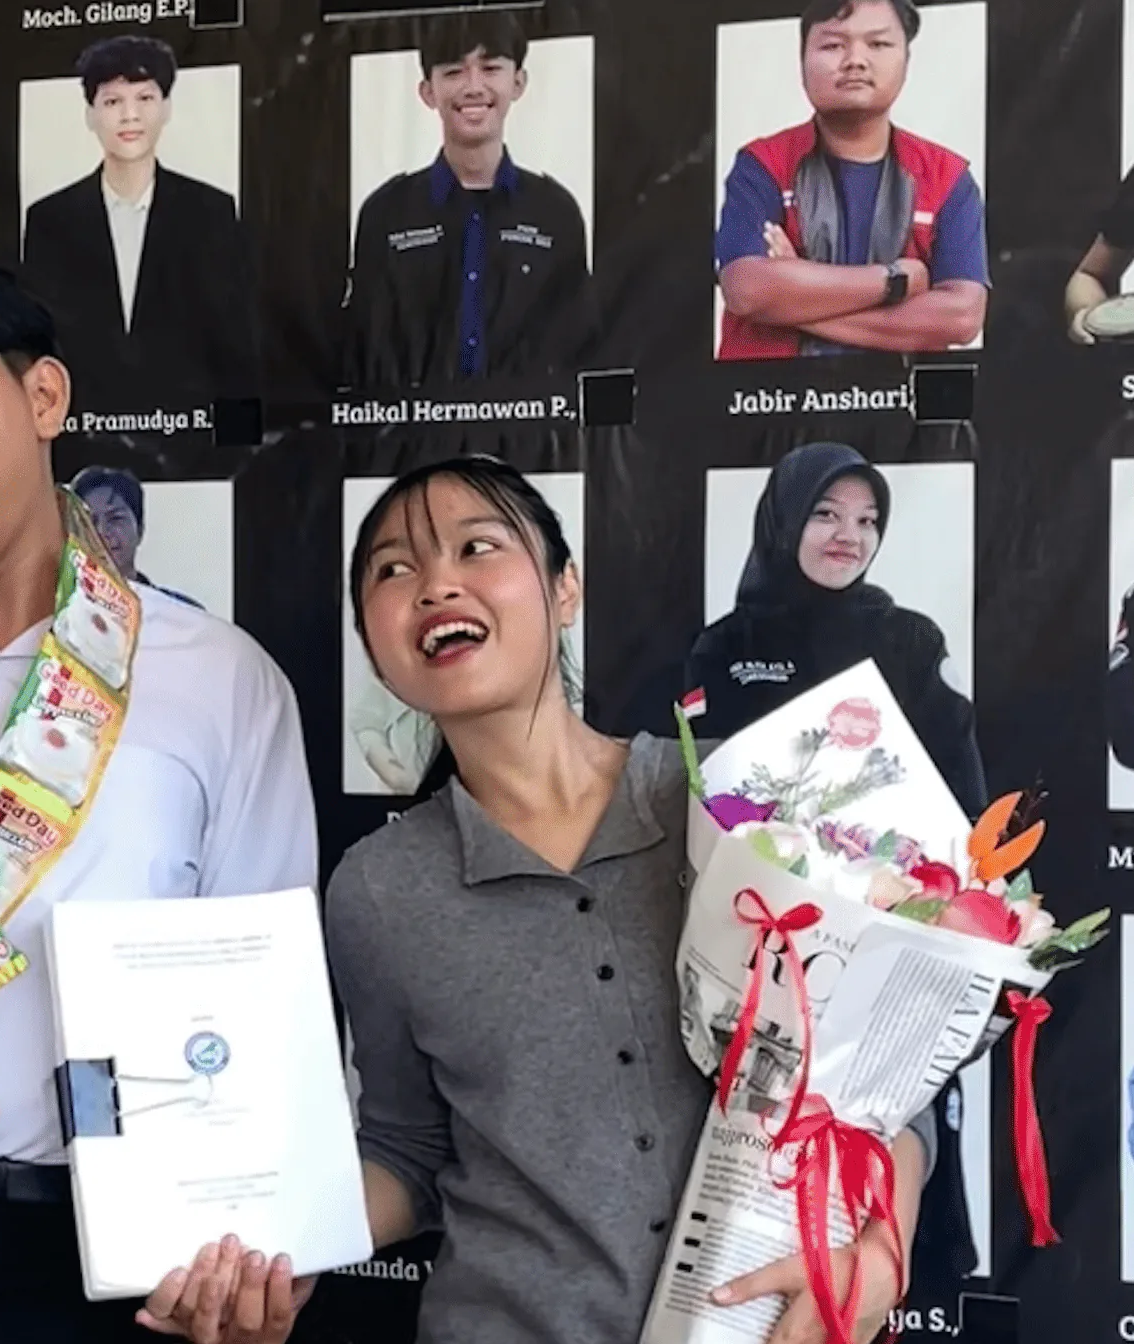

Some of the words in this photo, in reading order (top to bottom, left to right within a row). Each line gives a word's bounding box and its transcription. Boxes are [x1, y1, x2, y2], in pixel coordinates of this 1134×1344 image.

[21, 5, 83, 29] Moch.
[85, 1, 153, 24] Gilang
[331, 399, 408, 425] Haikal
[412, 399, 545, 422] Hermawan
[728, 387, 797, 415] Jabir
[81, 408, 189, 435] Pramudya
[39, 660, 82, 700] Good
